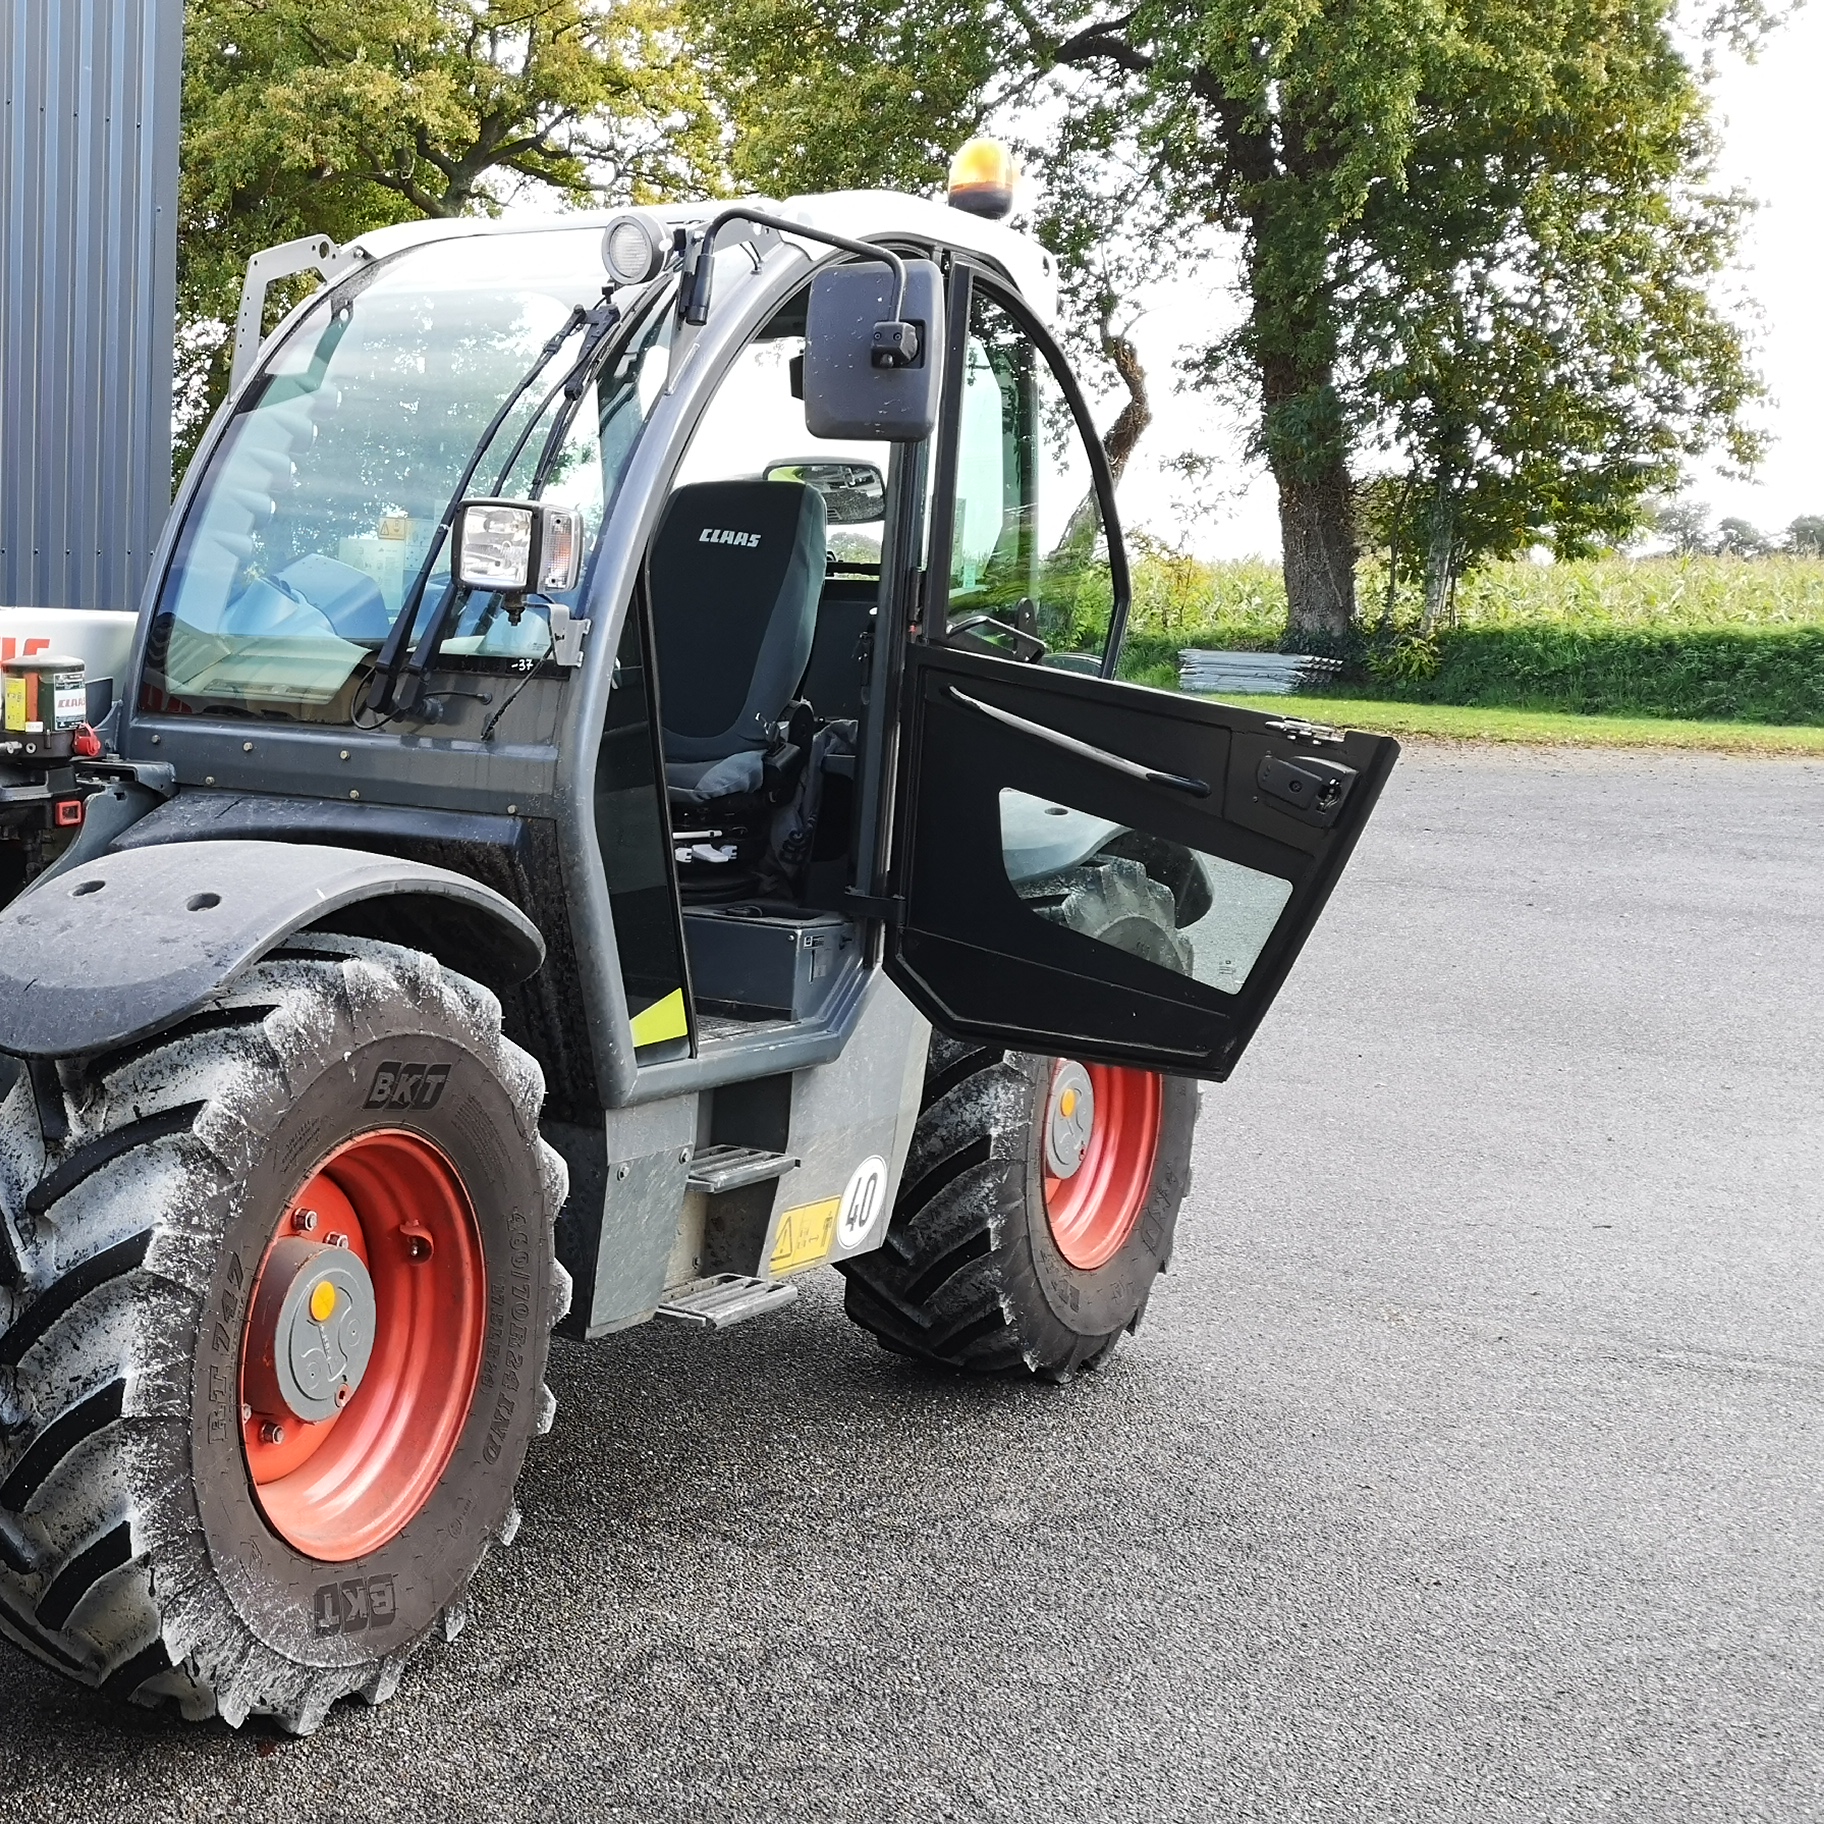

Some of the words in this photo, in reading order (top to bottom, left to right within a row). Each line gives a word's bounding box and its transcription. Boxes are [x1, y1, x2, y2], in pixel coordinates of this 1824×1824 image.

[699, 528, 762, 547] CLAAS
[365, 1065, 449, 1107] BKT
[845, 1172, 878, 1232] 40
[316, 1576, 395, 1634] BKT
